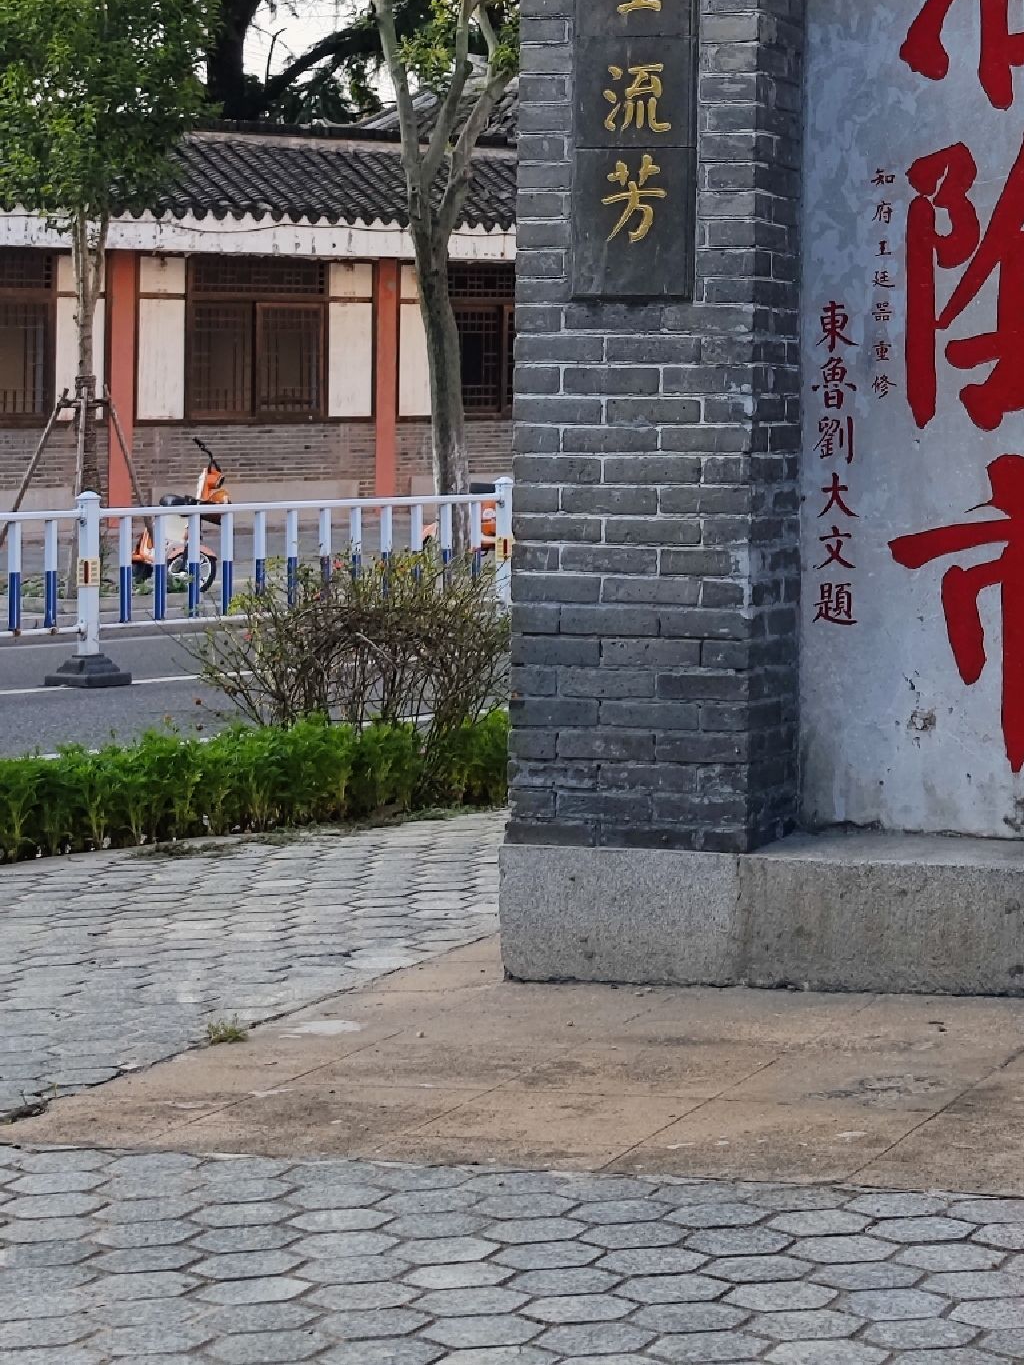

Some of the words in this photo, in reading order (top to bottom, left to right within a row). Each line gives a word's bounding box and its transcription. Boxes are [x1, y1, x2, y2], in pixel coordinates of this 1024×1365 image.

[811, 300, 860, 627] 東魯劉大文題
